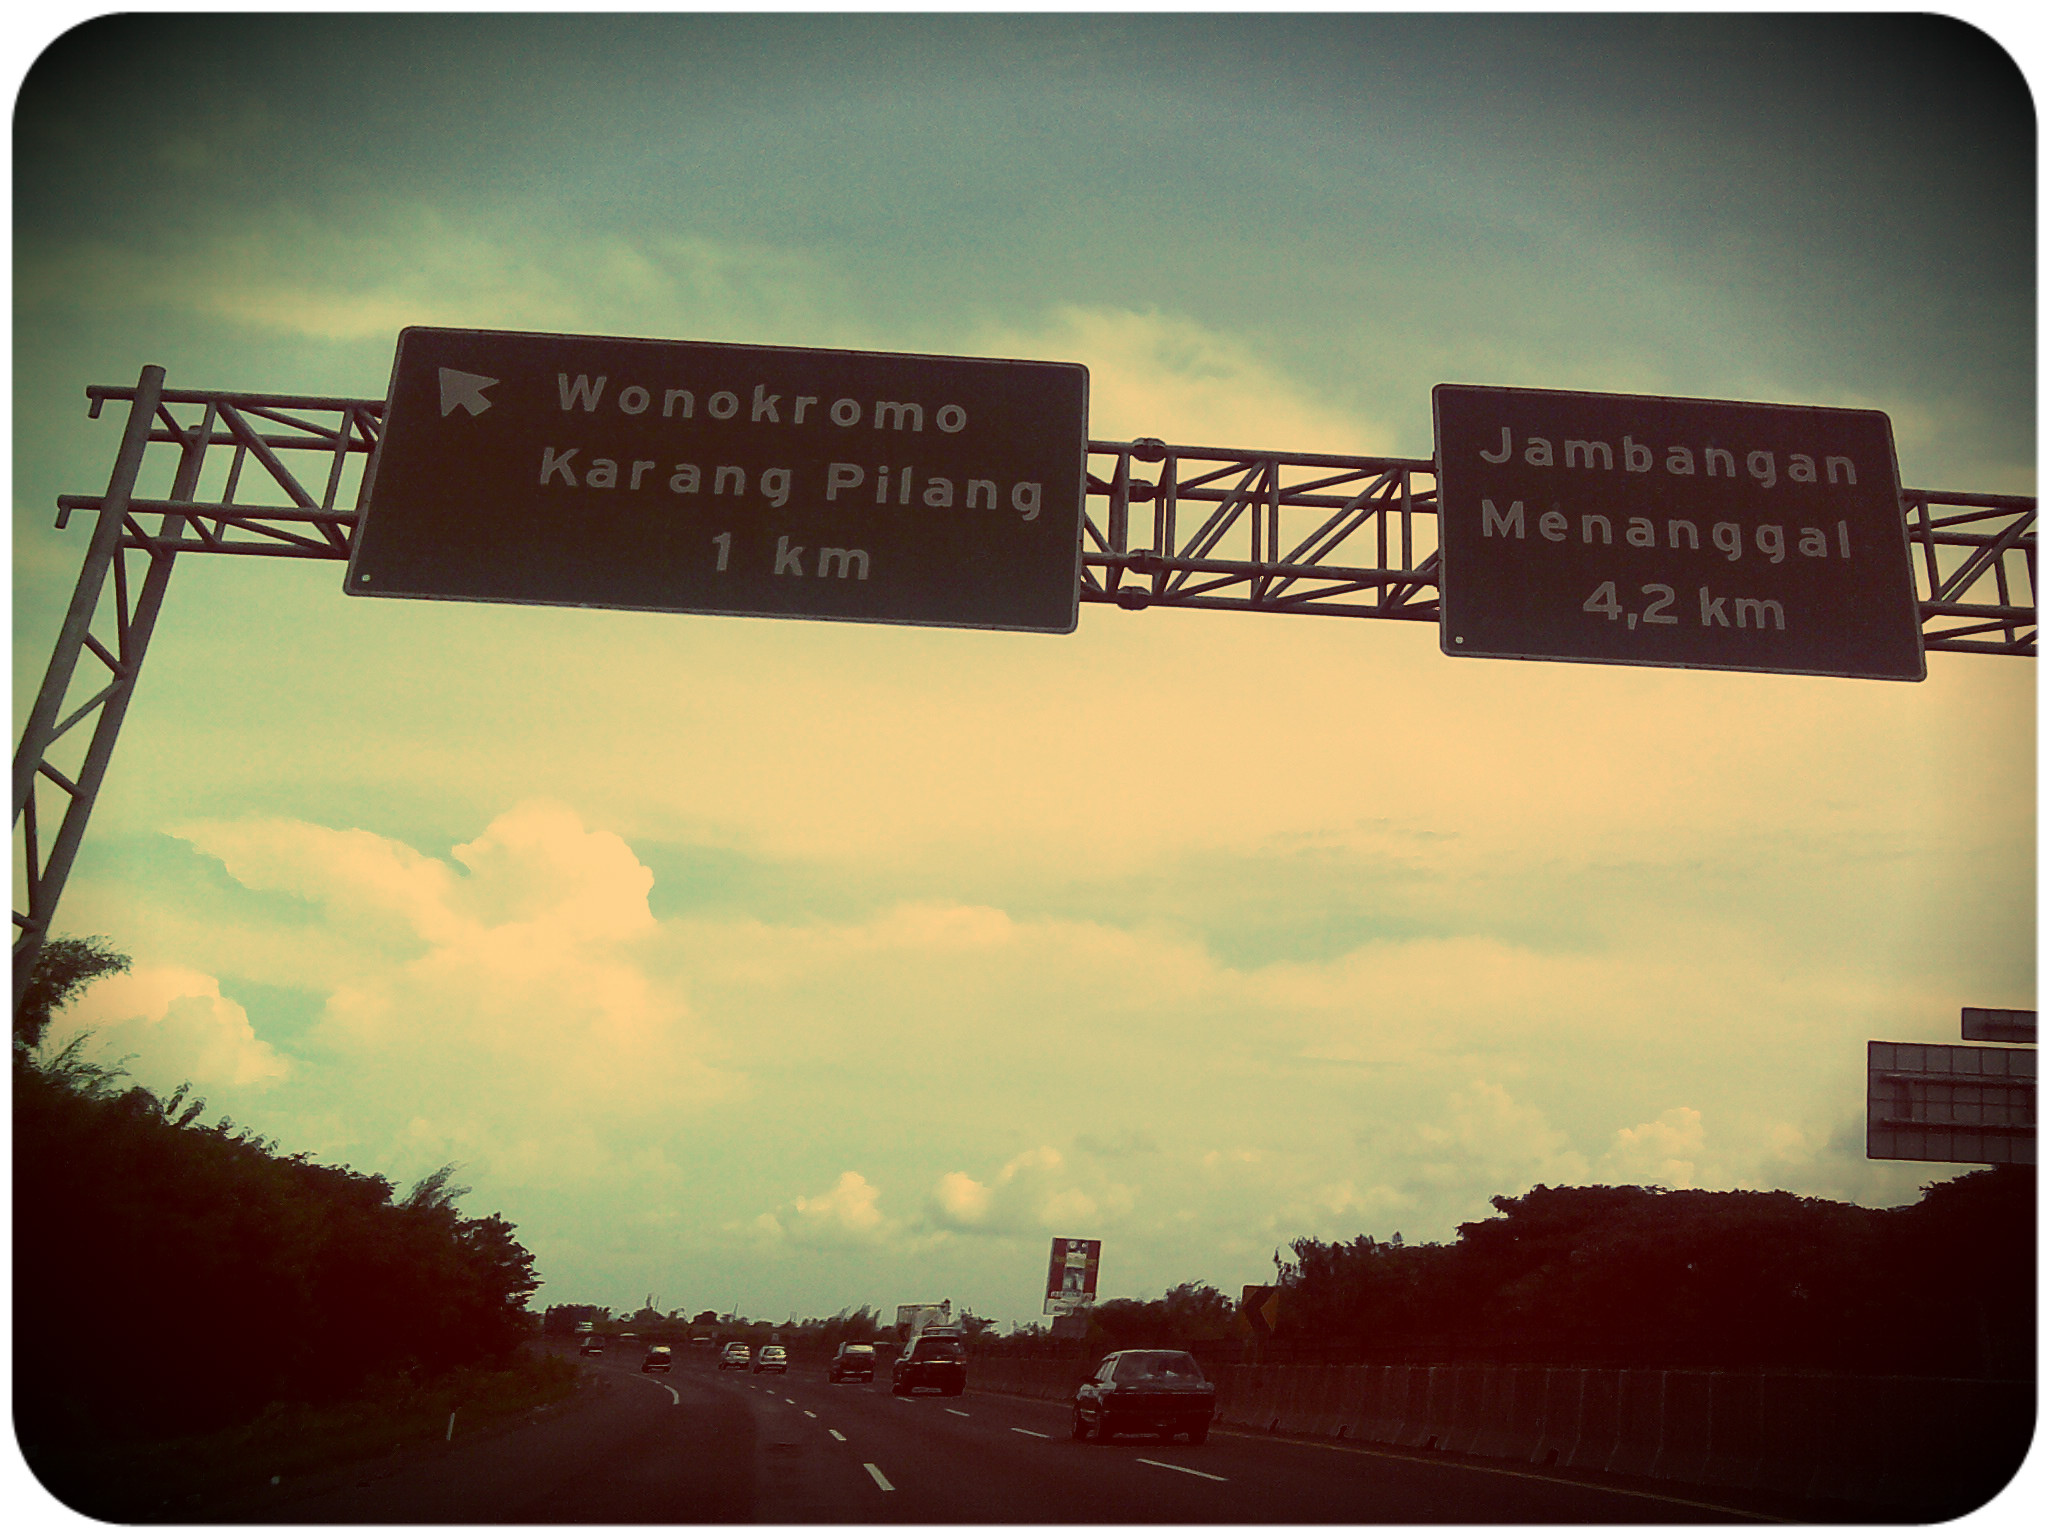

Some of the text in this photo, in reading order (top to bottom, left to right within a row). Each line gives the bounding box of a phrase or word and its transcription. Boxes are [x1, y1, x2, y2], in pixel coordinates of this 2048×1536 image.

[557, 373, 967, 433] Wonokromo
[540, 447, 1042, 521] Karang Pilang
[1480, 427, 1857, 489] Jambangan
[712, 532, 870, 581] 1 km
[1481, 499, 1850, 563] Menanggal
[1583, 580, 1786, 631] 4,2 km
